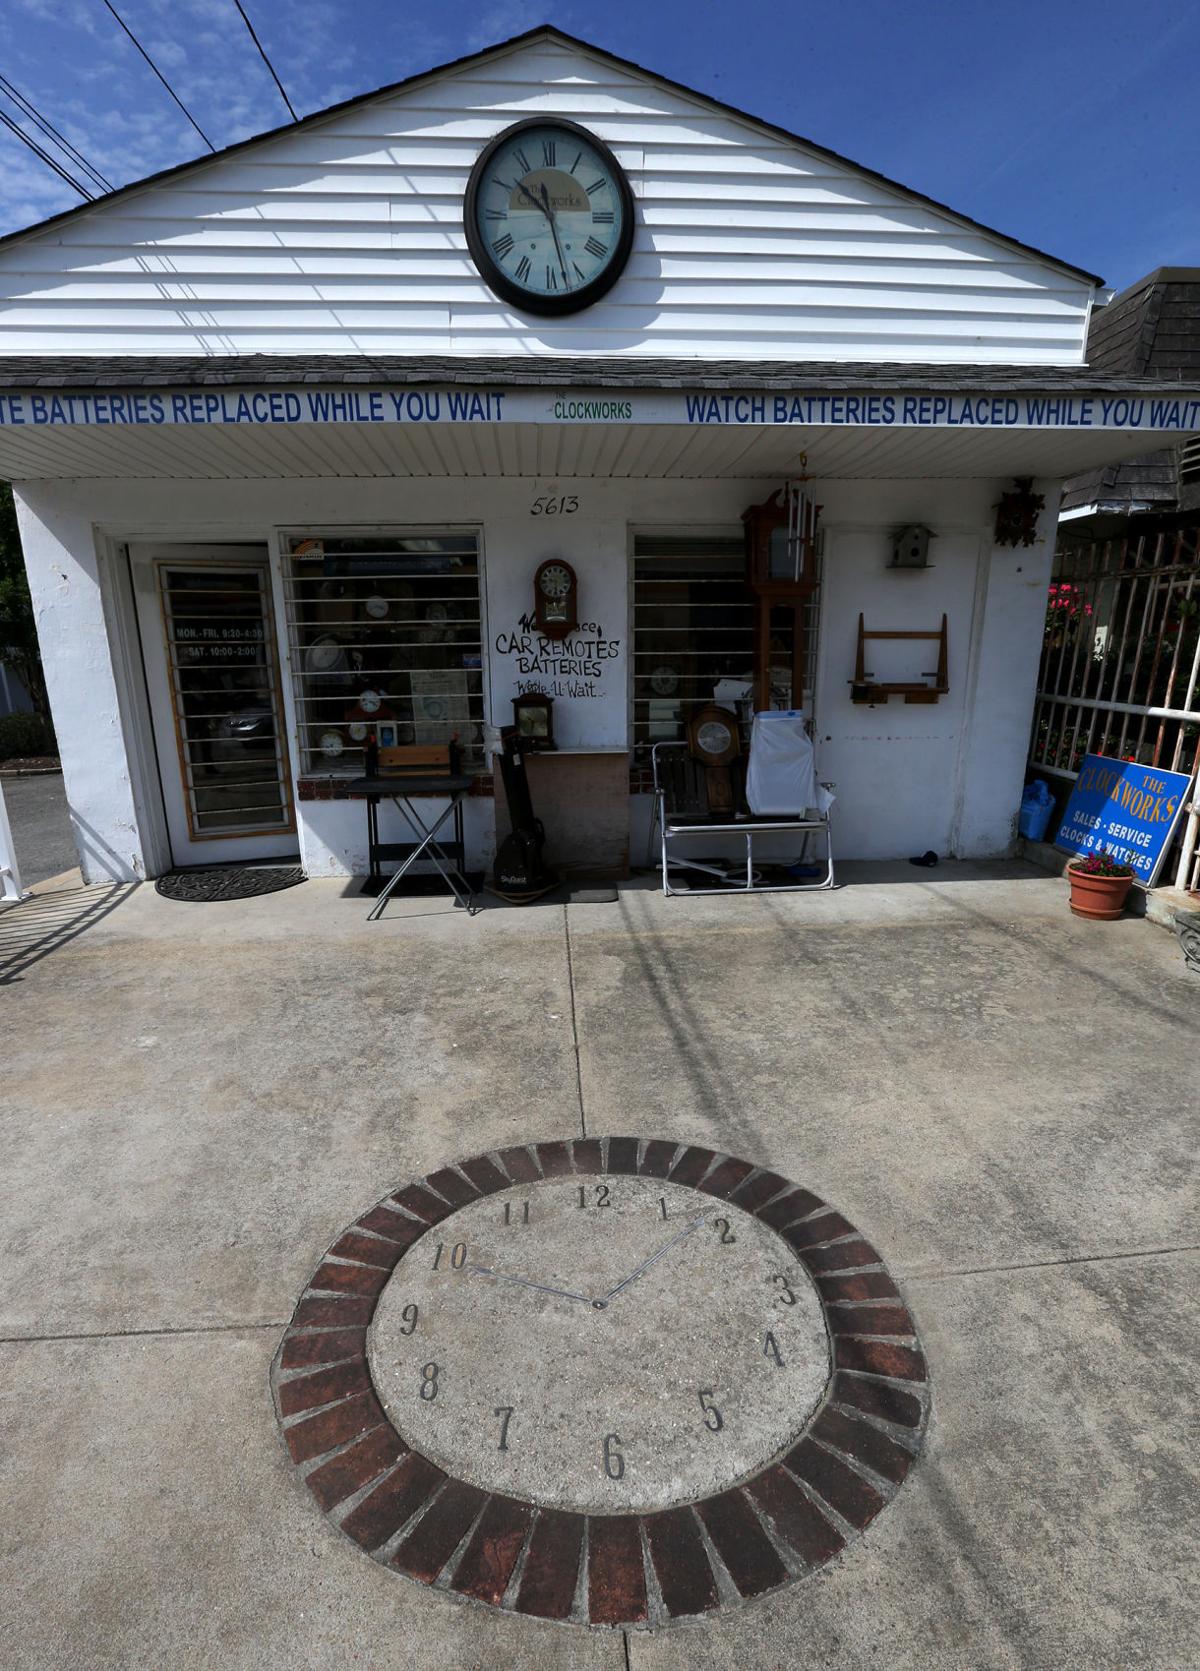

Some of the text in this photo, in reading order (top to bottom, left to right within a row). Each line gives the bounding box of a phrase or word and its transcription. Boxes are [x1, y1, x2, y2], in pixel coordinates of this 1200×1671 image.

[31, 395, 164, 424] BATTERIES
[172, 393, 301, 423] REPLACED
[307, 392, 384, 421] WHILE
[390, 392, 440, 421] YOU
[448, 392, 505, 421] WAIT
[554, 401, 633, 419] CLOCKWORKS
[555, 391, 568, 400] THE
[686, 395, 1200, 429] WATCH BATTERIES REPLACED WHILE YOU WAIT
[530, 496, 579, 516] 5613
[496, 633, 620, 659] CAR REMOTES
[516, 656, 602, 677] BATTERIES
[1077, 767, 1179, 823] CLOCKWORKS
[1142, 775, 1167, 794] THE
[1073, 811, 1152, 848] SALES SERVICE
[1061, 825, 1153, 871] CLOCKS & WATCHES
[576, 1185, 611, 1208] 12
[658, 1197, 670, 1221] 1
[503, 1201, 531, 1226] 11
[714, 1218, 736, 1245] 2
[431, 1242, 467, 1271] 10
[772, 1274, 796, 1306] 3
[401, 1304, 418, 1335] 9
[764, 1331, 785, 1367] 4
[420, 1362, 440, 1401] 8
[700, 1390, 724, 1432] 5
[494, 1406, 514, 1452] 7
[603, 1433, 625, 1480] 6
